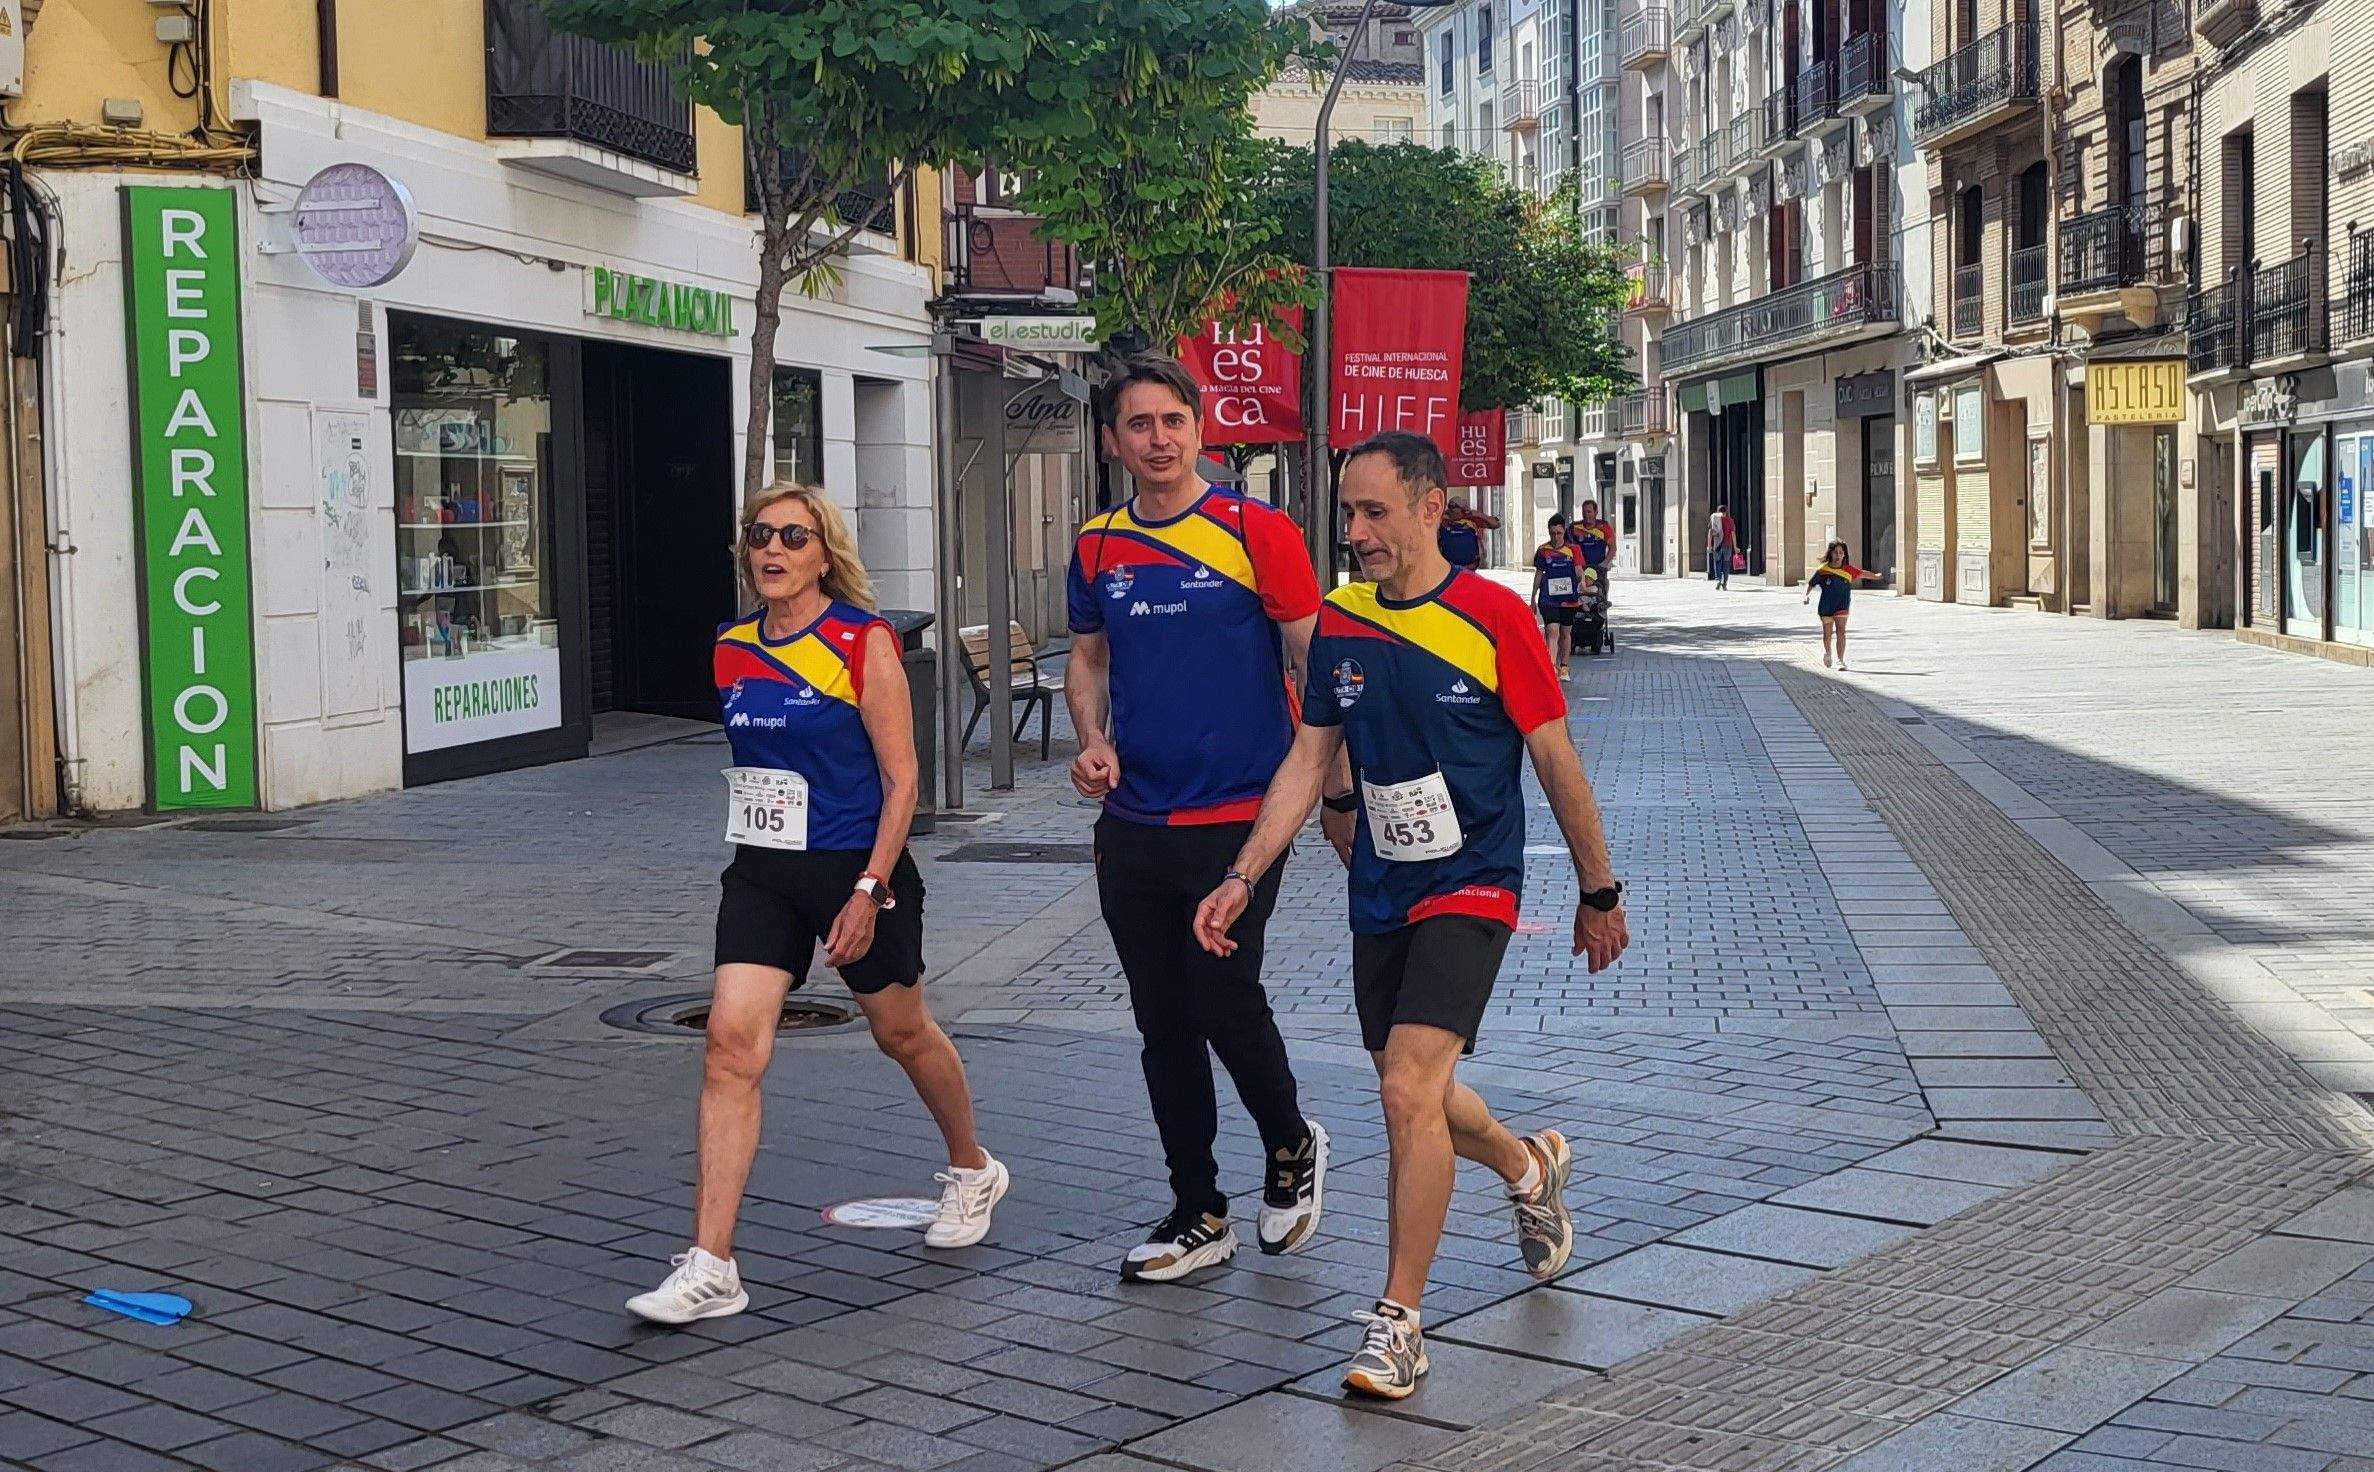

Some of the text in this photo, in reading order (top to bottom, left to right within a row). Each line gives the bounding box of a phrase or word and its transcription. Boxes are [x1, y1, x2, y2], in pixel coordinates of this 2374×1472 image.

[1213, 349, 1262, 382] es
[1345, 352, 1448, 363] FESTIVAL INTERNACIONAL
[1345, 365, 1448, 380] DE CINE DE HUESCA
[2095, 365, 2177, 410] ASCASO
[1215, 397, 1268, 426] ca
[1342, 393, 1447, 434] HIFF
[2097, 412, 2177, 420] PASTELERIA
[1461, 439, 1487, 456] es
[1461, 463, 1487, 478] ca
[162, 209, 228, 793] REPARACION
[1180, 580, 1223, 589] Santander
[1153, 600, 1187, 616] mupol
[434, 674, 539, 723] REPARACIONES
[1435, 693, 1481, 704] Santander
[753, 715, 786, 729] mupol
[743, 805, 785, 832] 105
[1383, 820, 1435, 846] 453
